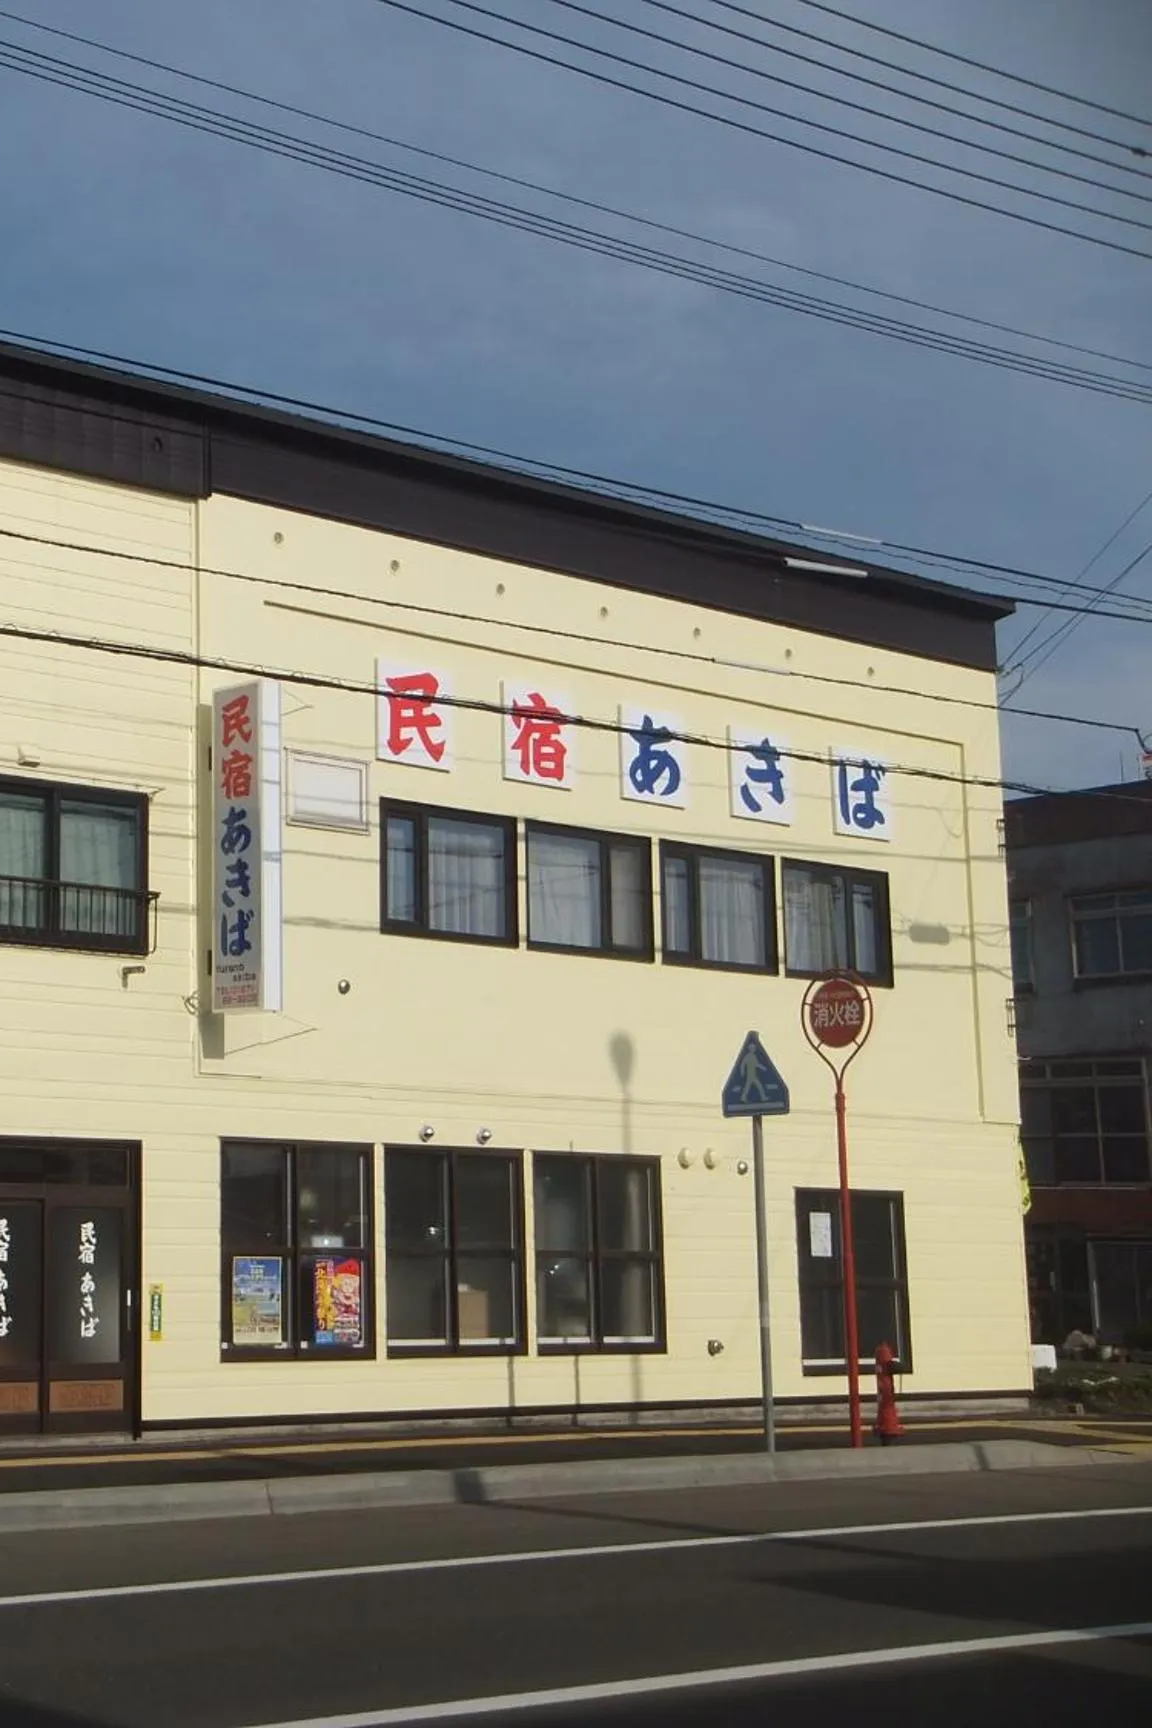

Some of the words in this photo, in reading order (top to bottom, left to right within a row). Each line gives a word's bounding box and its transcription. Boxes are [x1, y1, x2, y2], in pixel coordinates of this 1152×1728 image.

[386, 673, 886, 829] 民宿あきば
[220, 694, 254, 956] 民宿あきば
[813, 1000, 860, 1027] 消火栓
[78, 1222, 100, 1338] 民宿あきば
